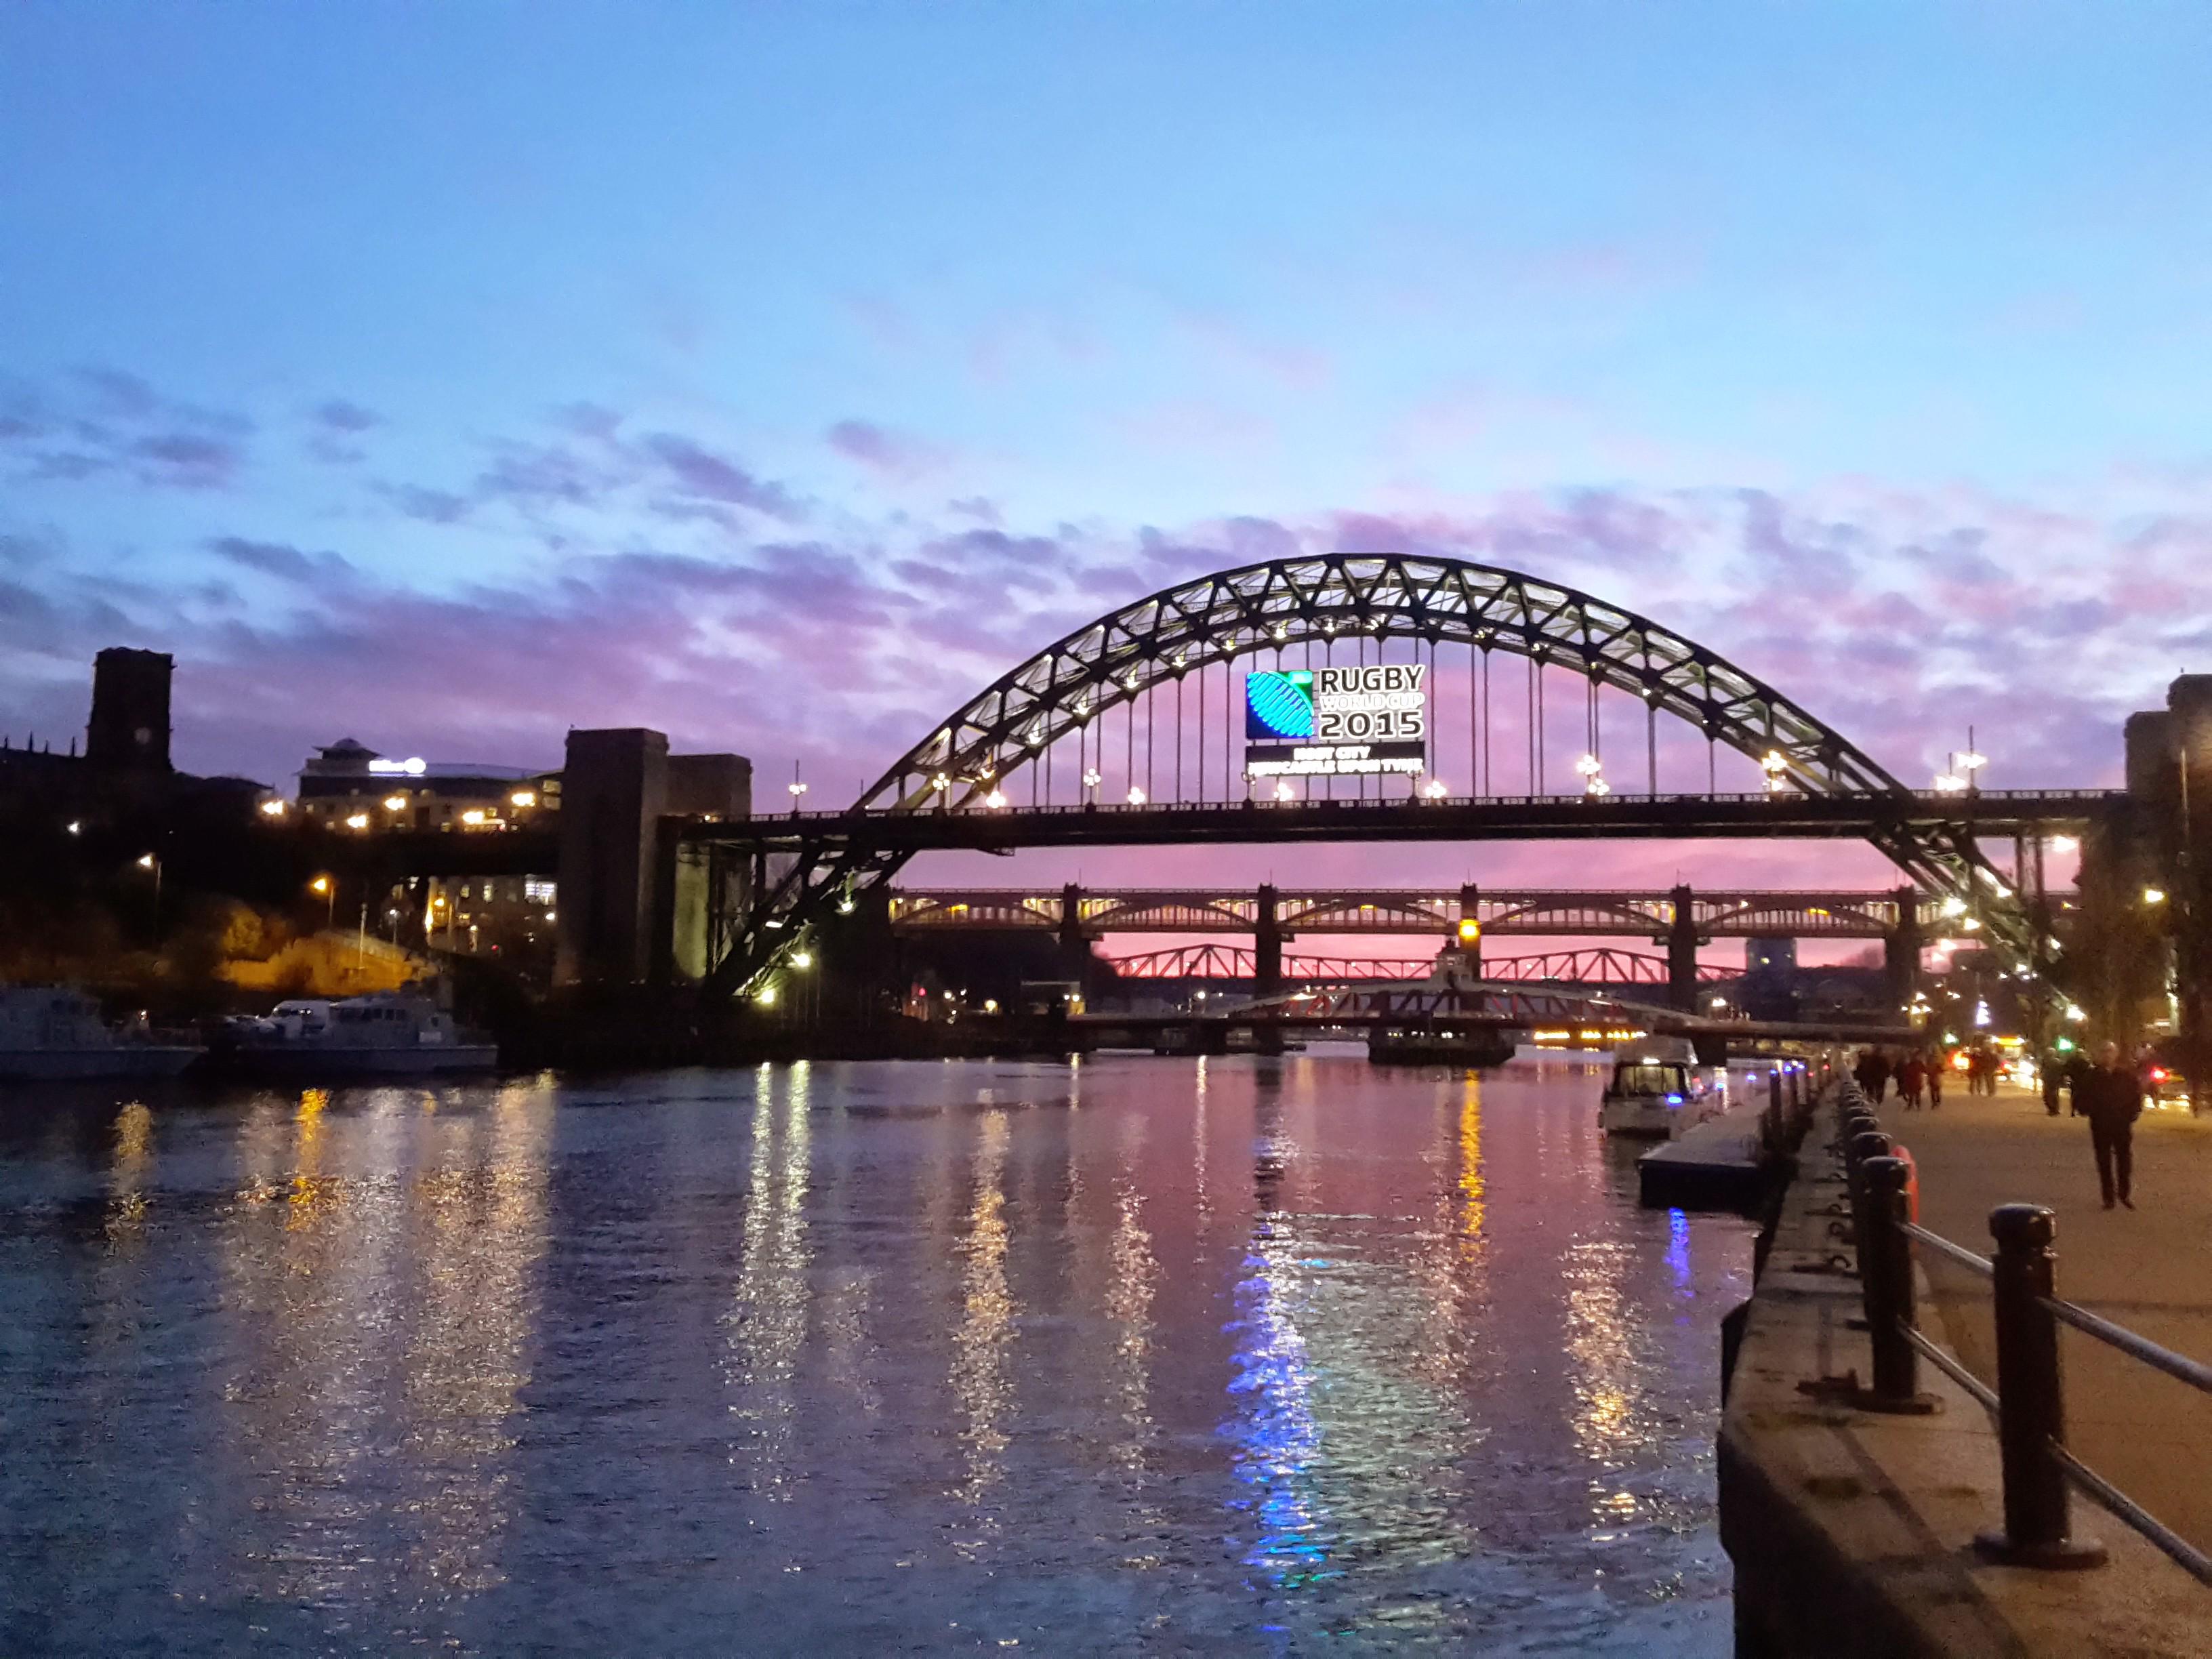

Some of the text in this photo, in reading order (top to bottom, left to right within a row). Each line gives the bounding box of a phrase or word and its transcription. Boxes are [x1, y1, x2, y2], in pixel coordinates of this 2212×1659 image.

[1320, 666, 1423, 693] RUGBY
[1320, 692, 1425, 711] WORLD CUP
[1320, 711, 1422, 737] 2015
